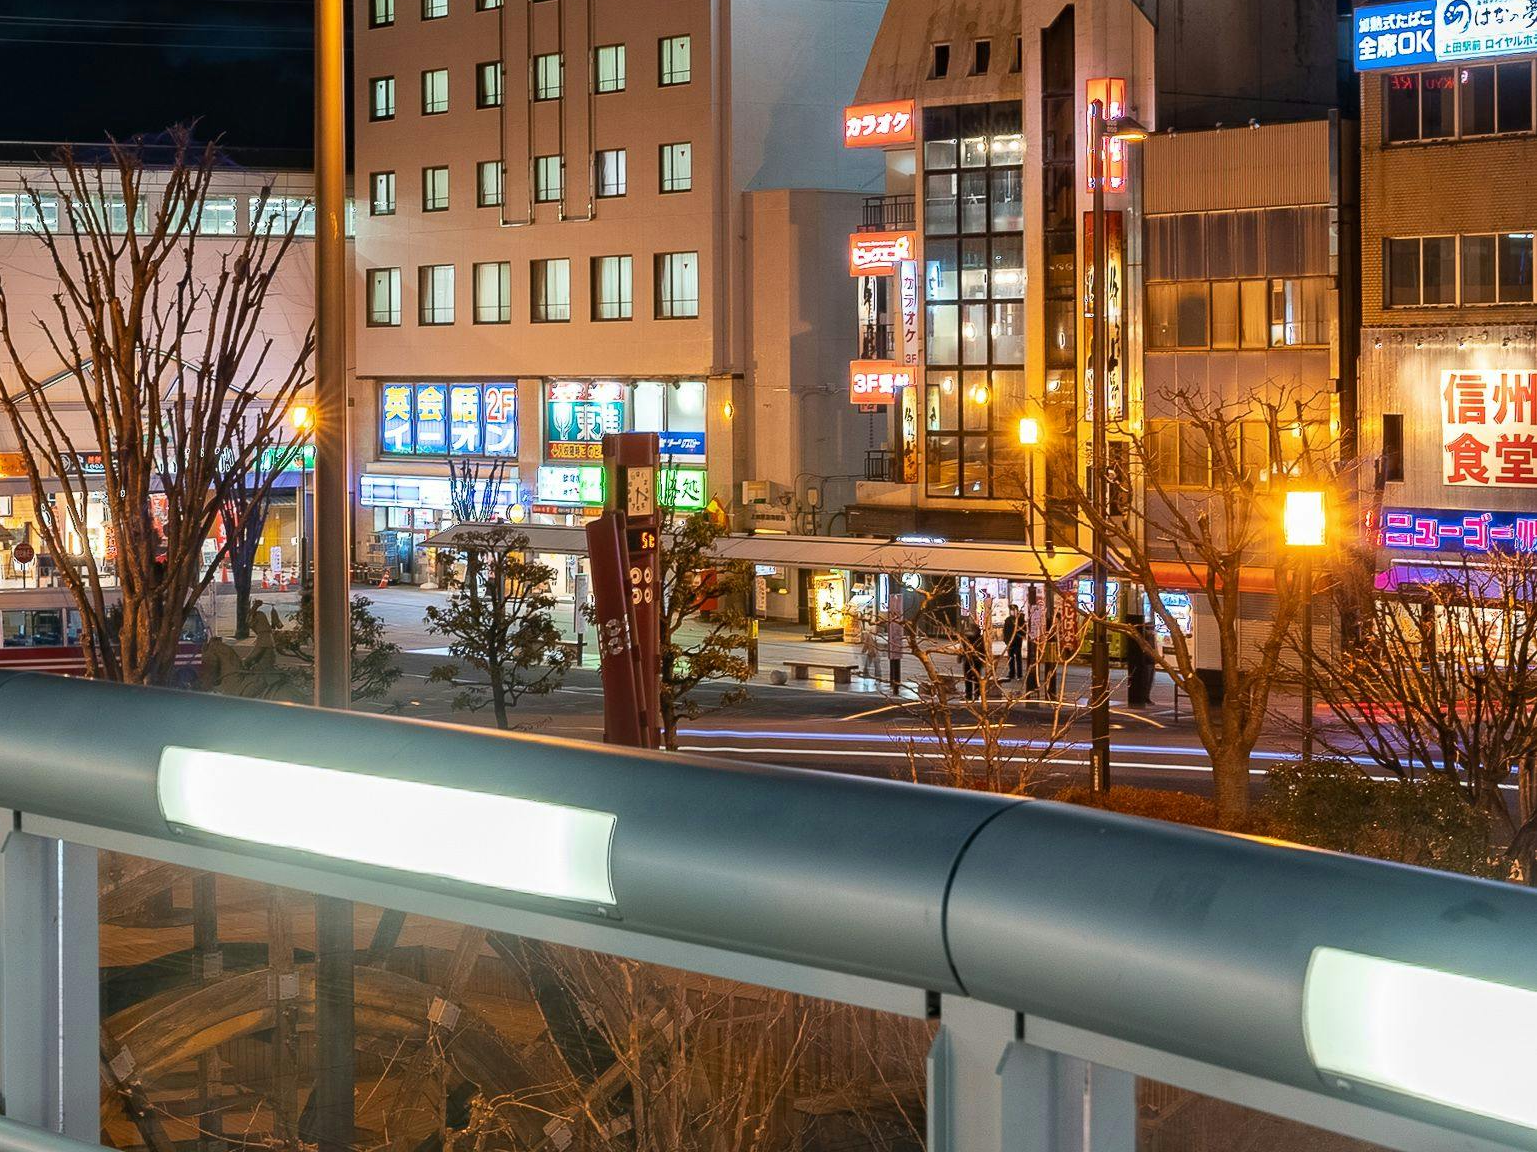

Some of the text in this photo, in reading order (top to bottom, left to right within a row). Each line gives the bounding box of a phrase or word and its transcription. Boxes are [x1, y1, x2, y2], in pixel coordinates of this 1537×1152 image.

[1358, 29, 1434, 61] 全席OK
[1443, 39, 1482, 55] 上田駅前
[845, 113, 910, 138] カラオケ
[904, 276, 916, 344] カラオケ
[905, 353, 917, 364] 3F
[384, 386, 479, 422] 英会話
[485, 388, 516, 423] 2F
[1443, 372, 1537, 426] 信州
[384, 423, 515, 452] イーオン
[1444, 432, 1537, 485] 食堂
